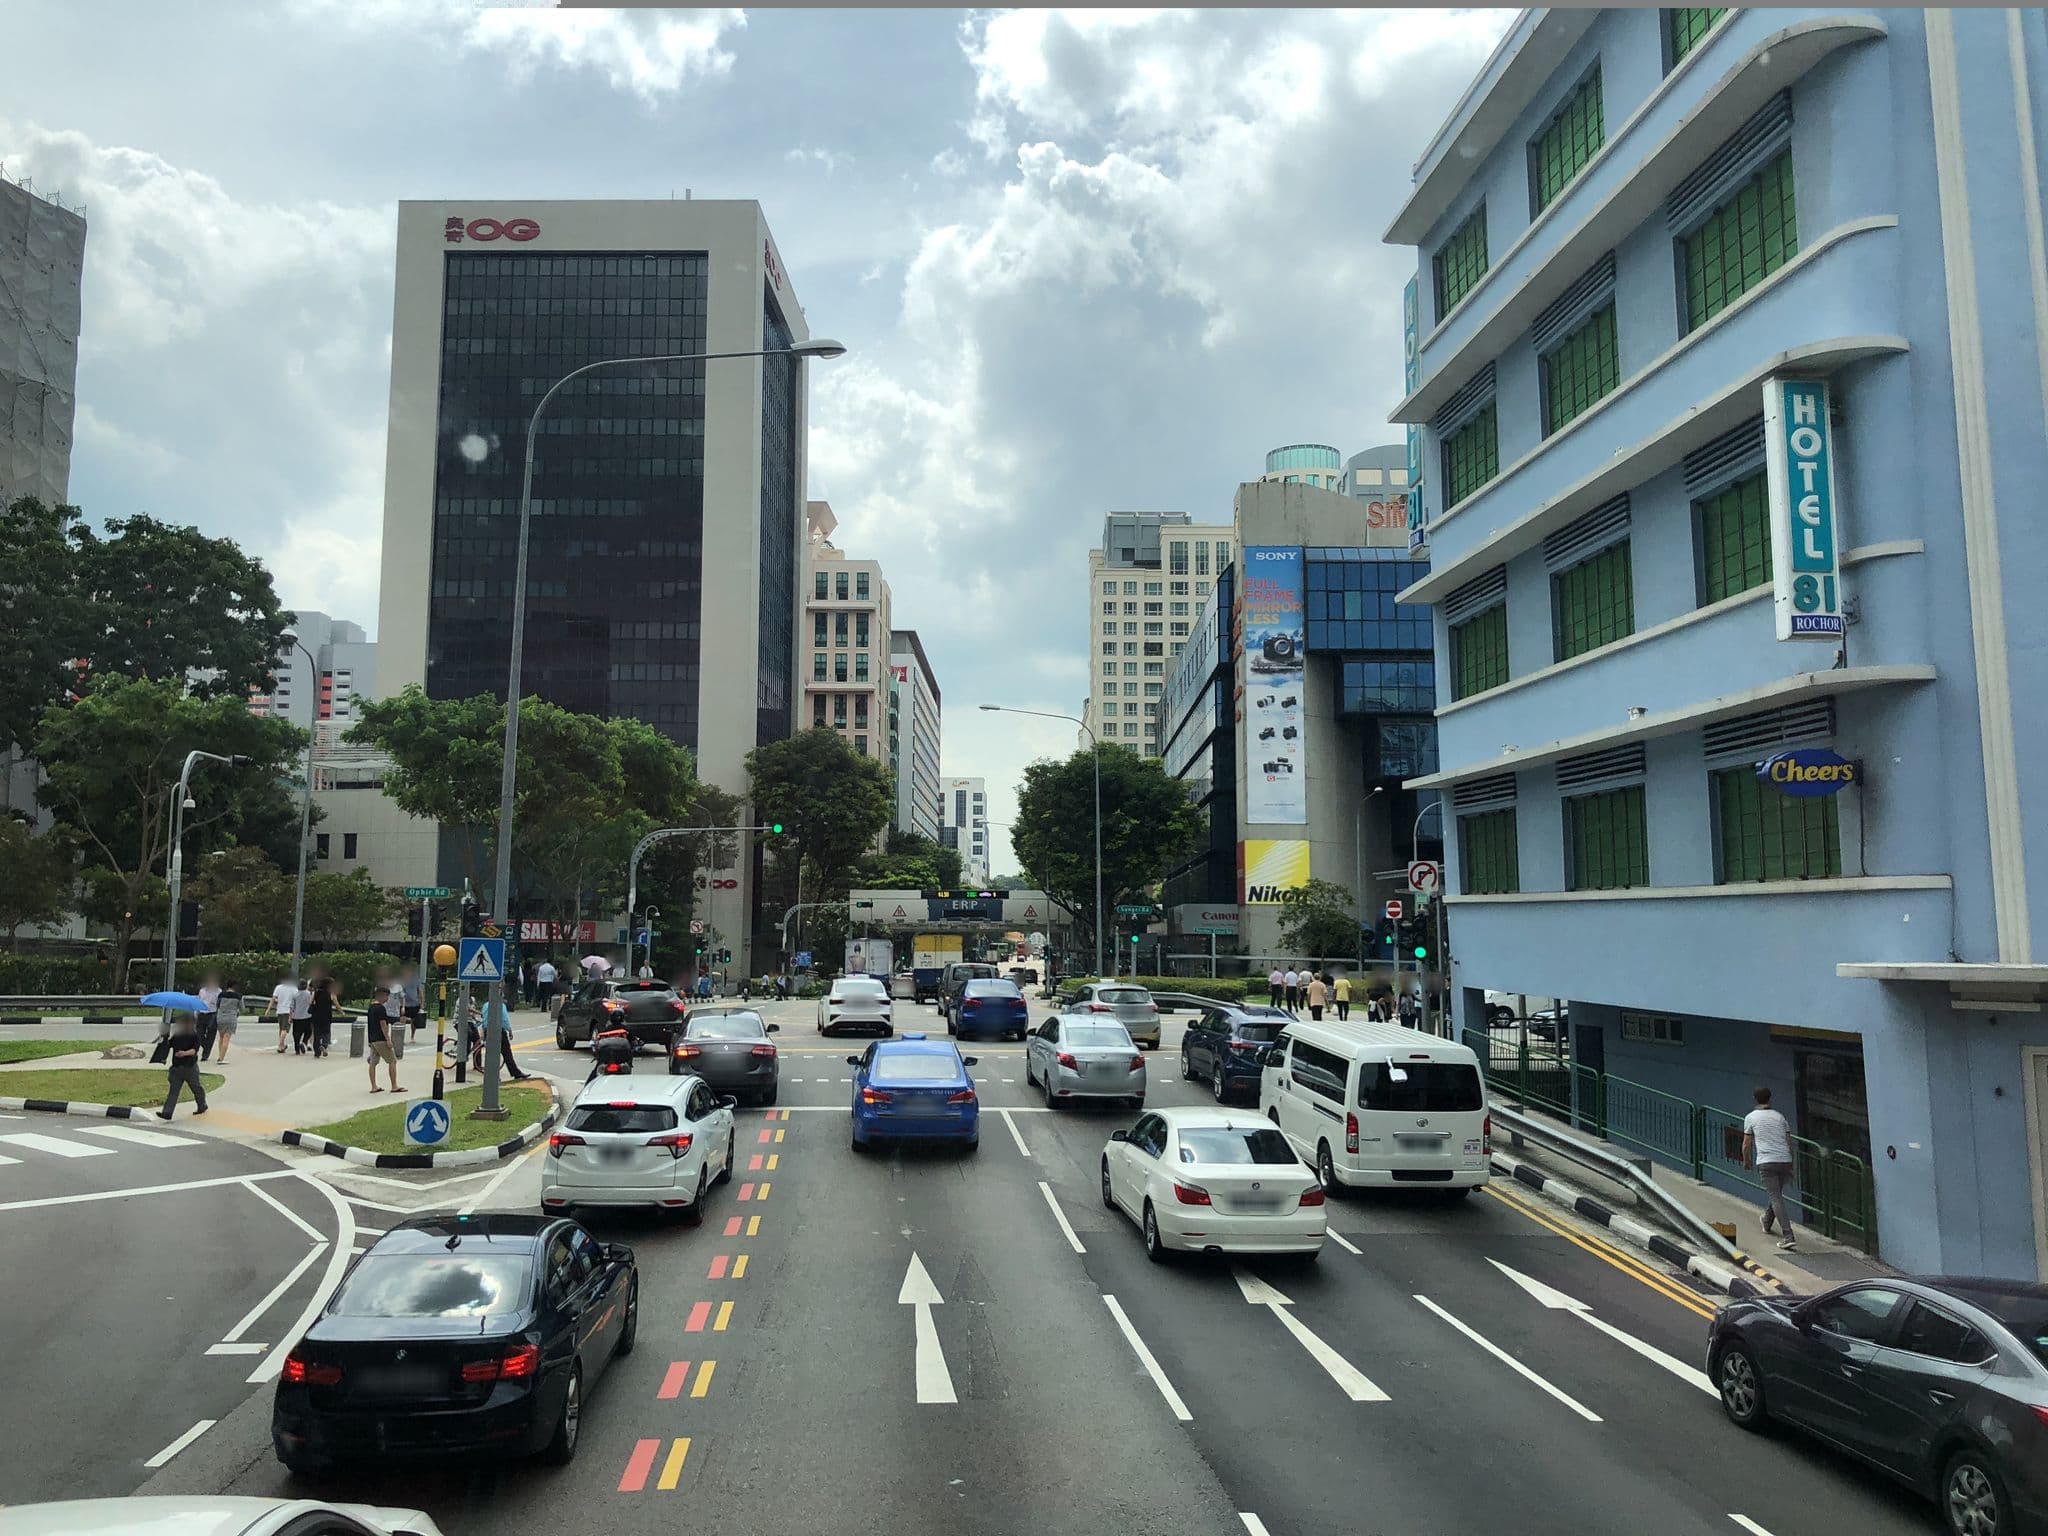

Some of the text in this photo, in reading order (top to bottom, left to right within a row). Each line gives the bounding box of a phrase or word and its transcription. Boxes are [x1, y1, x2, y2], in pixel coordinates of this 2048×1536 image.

[466, 218, 541, 242] OG
[1790, 394, 1825, 559] HOTEL
[1255, 552, 1298, 561] SONY
[1244, 577, 1280, 590] FULL
[1244, 589, 1296, 602] FRAME
[1793, 574, 1836, 614] 81
[1245, 601, 1304, 613] MIRROR
[1245, 613, 1280, 625] LESS
[1796, 616, 1841, 633] ROCHOR
[1769, 759, 1855, 784] Cheers
[410, 889, 433, 897] Ophir
[952, 900, 978, 910] ERP
[1201, 911, 1239, 921] Canon
